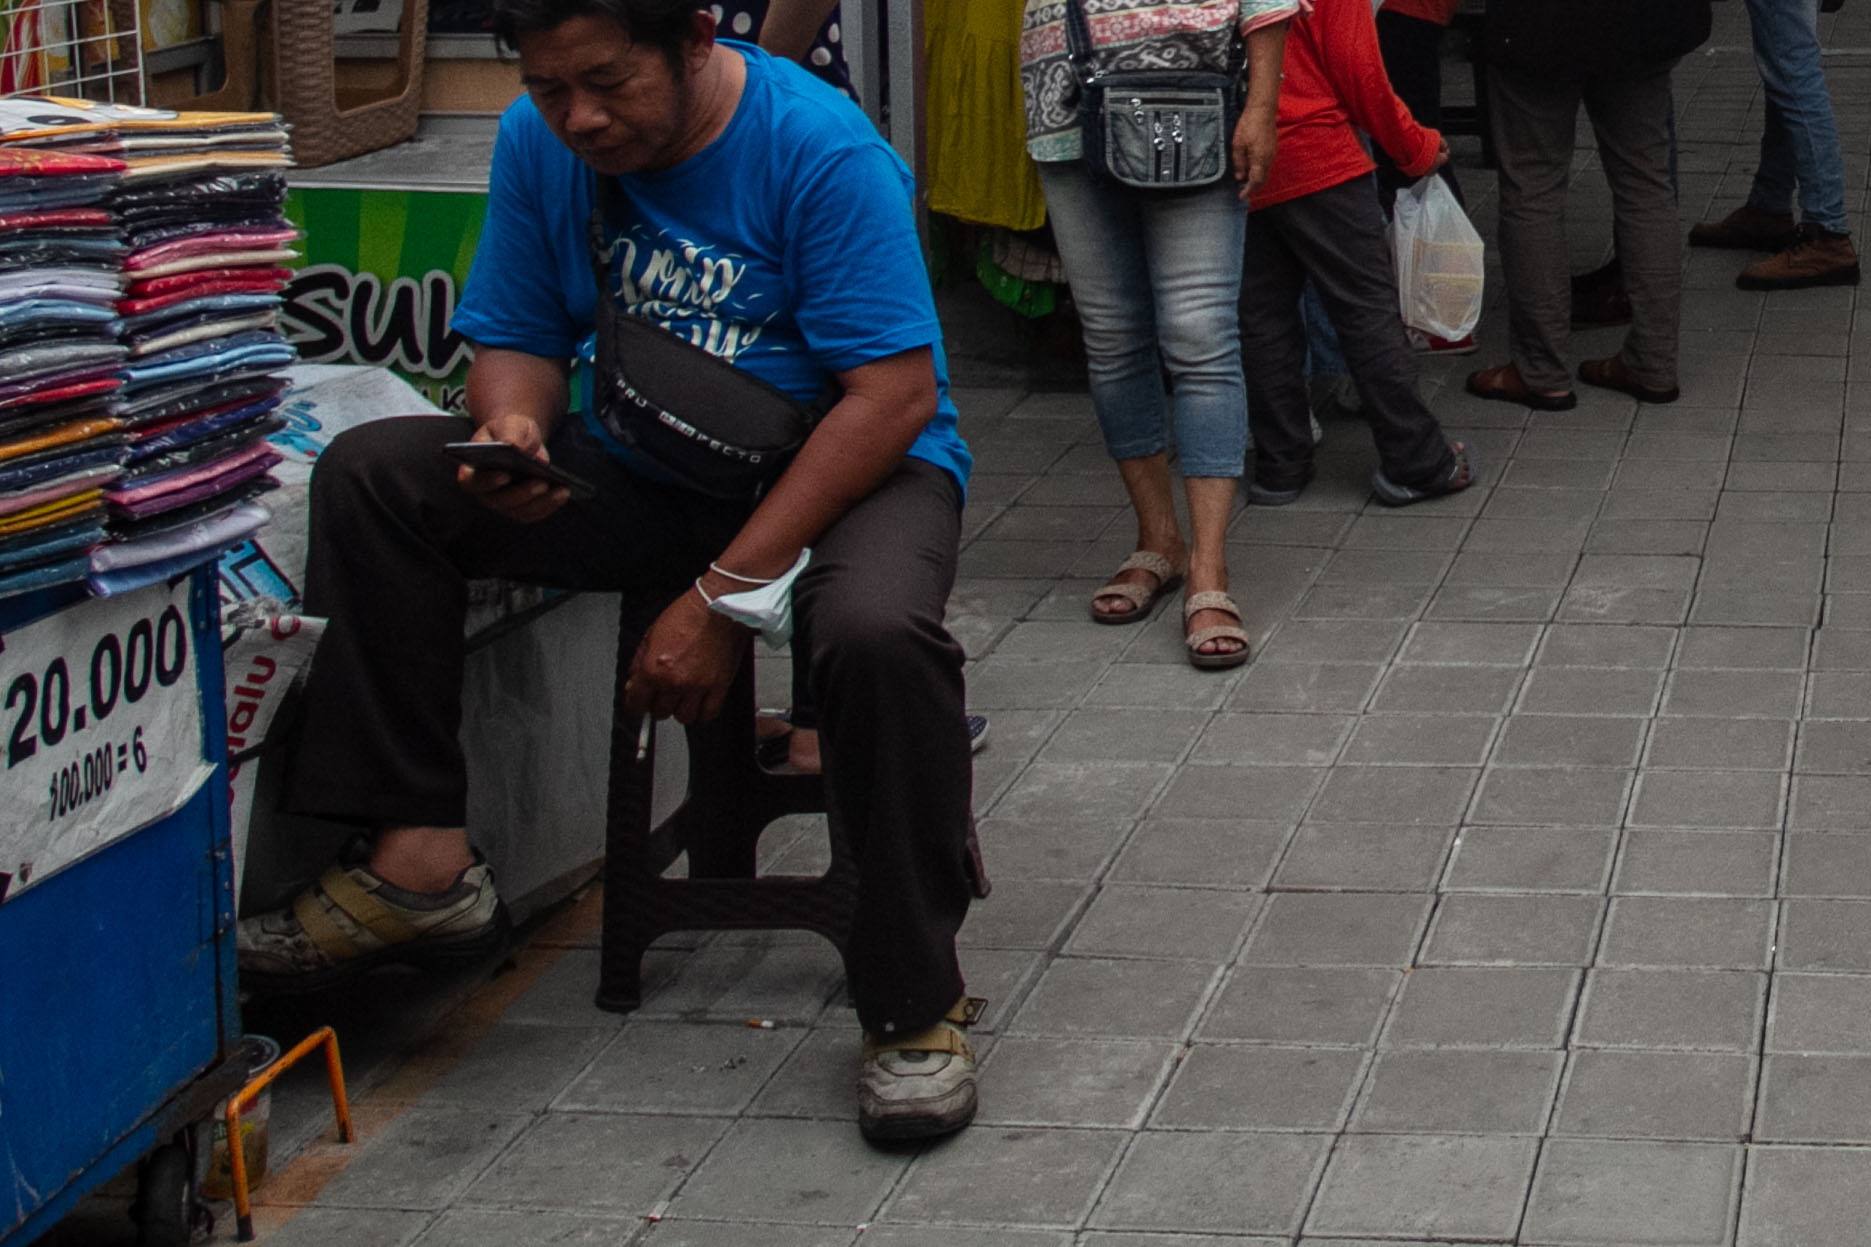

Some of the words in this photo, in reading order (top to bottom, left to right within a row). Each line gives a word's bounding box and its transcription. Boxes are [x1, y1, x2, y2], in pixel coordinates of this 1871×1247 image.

[5, 603, 188, 770] 20.000
[49, 742, 113, 821] 100.000
[131, 725, 148, 773] 6
